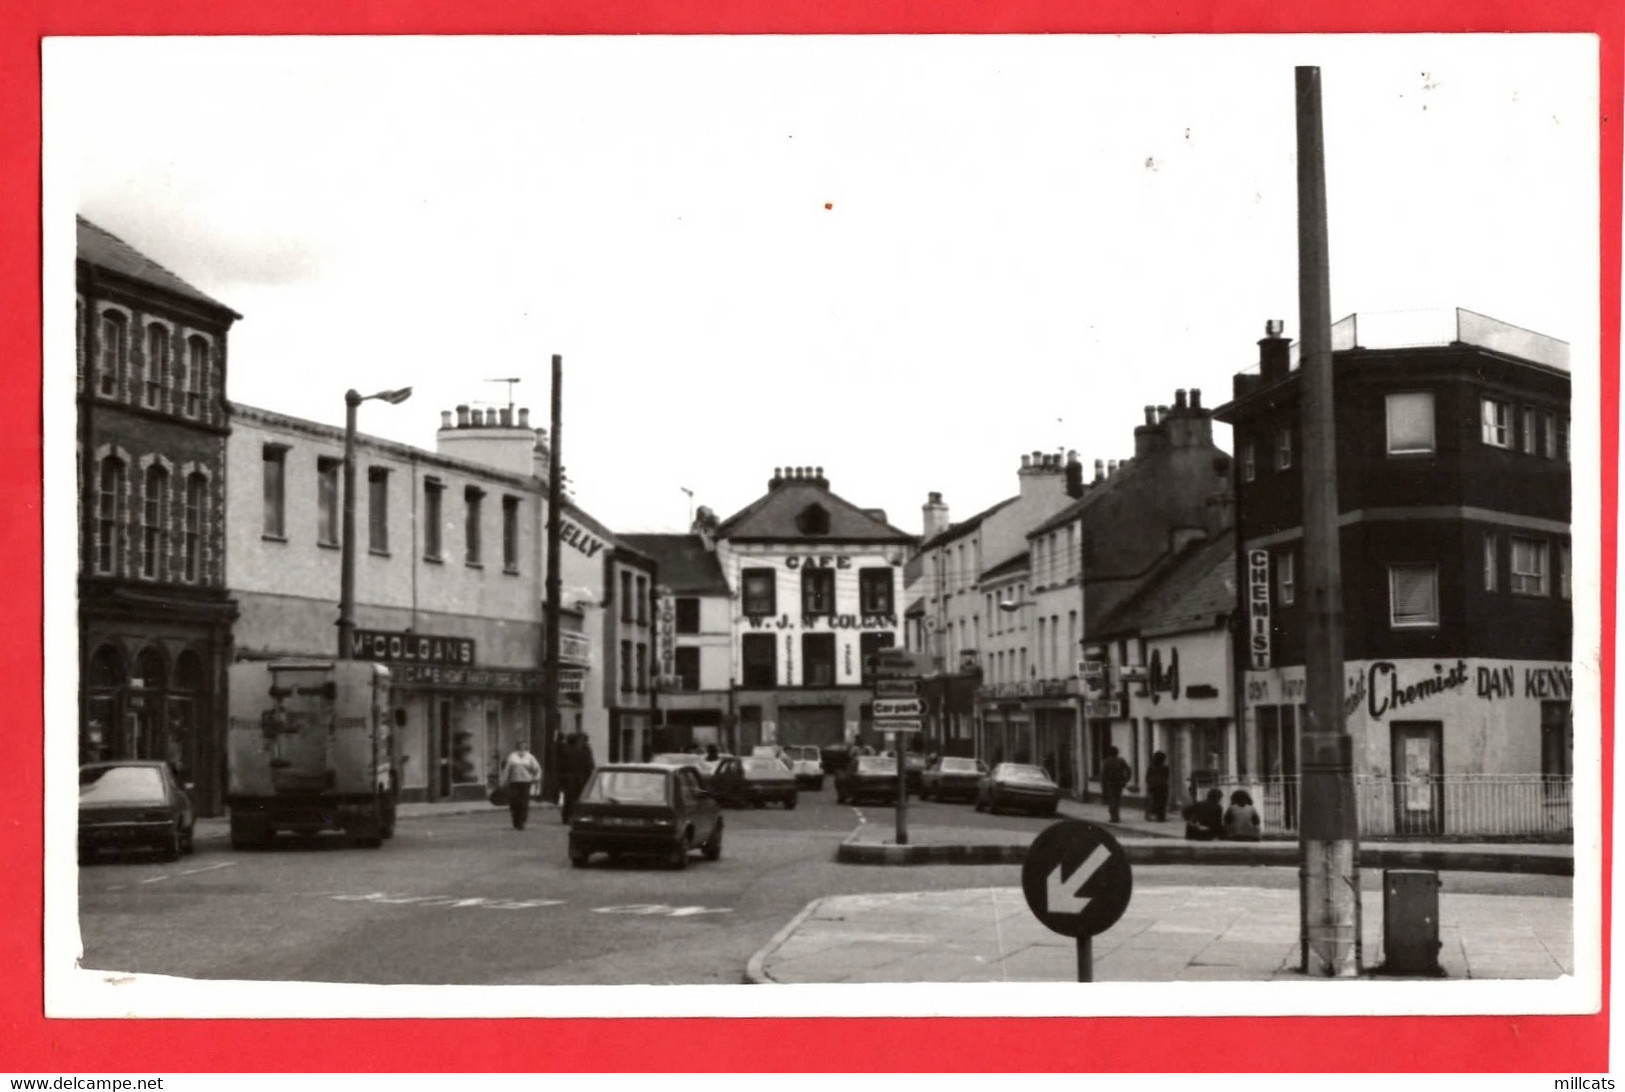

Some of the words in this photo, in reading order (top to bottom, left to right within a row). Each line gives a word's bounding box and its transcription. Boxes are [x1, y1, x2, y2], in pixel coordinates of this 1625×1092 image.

[785, 555, 852, 569] CAFE
[1251, 551, 1268, 667] CHEMIST
[1367, 660, 1469, 718] Chemist
[1476, 665, 1515, 701] DAN
[875, 702, 893, 713] Car
